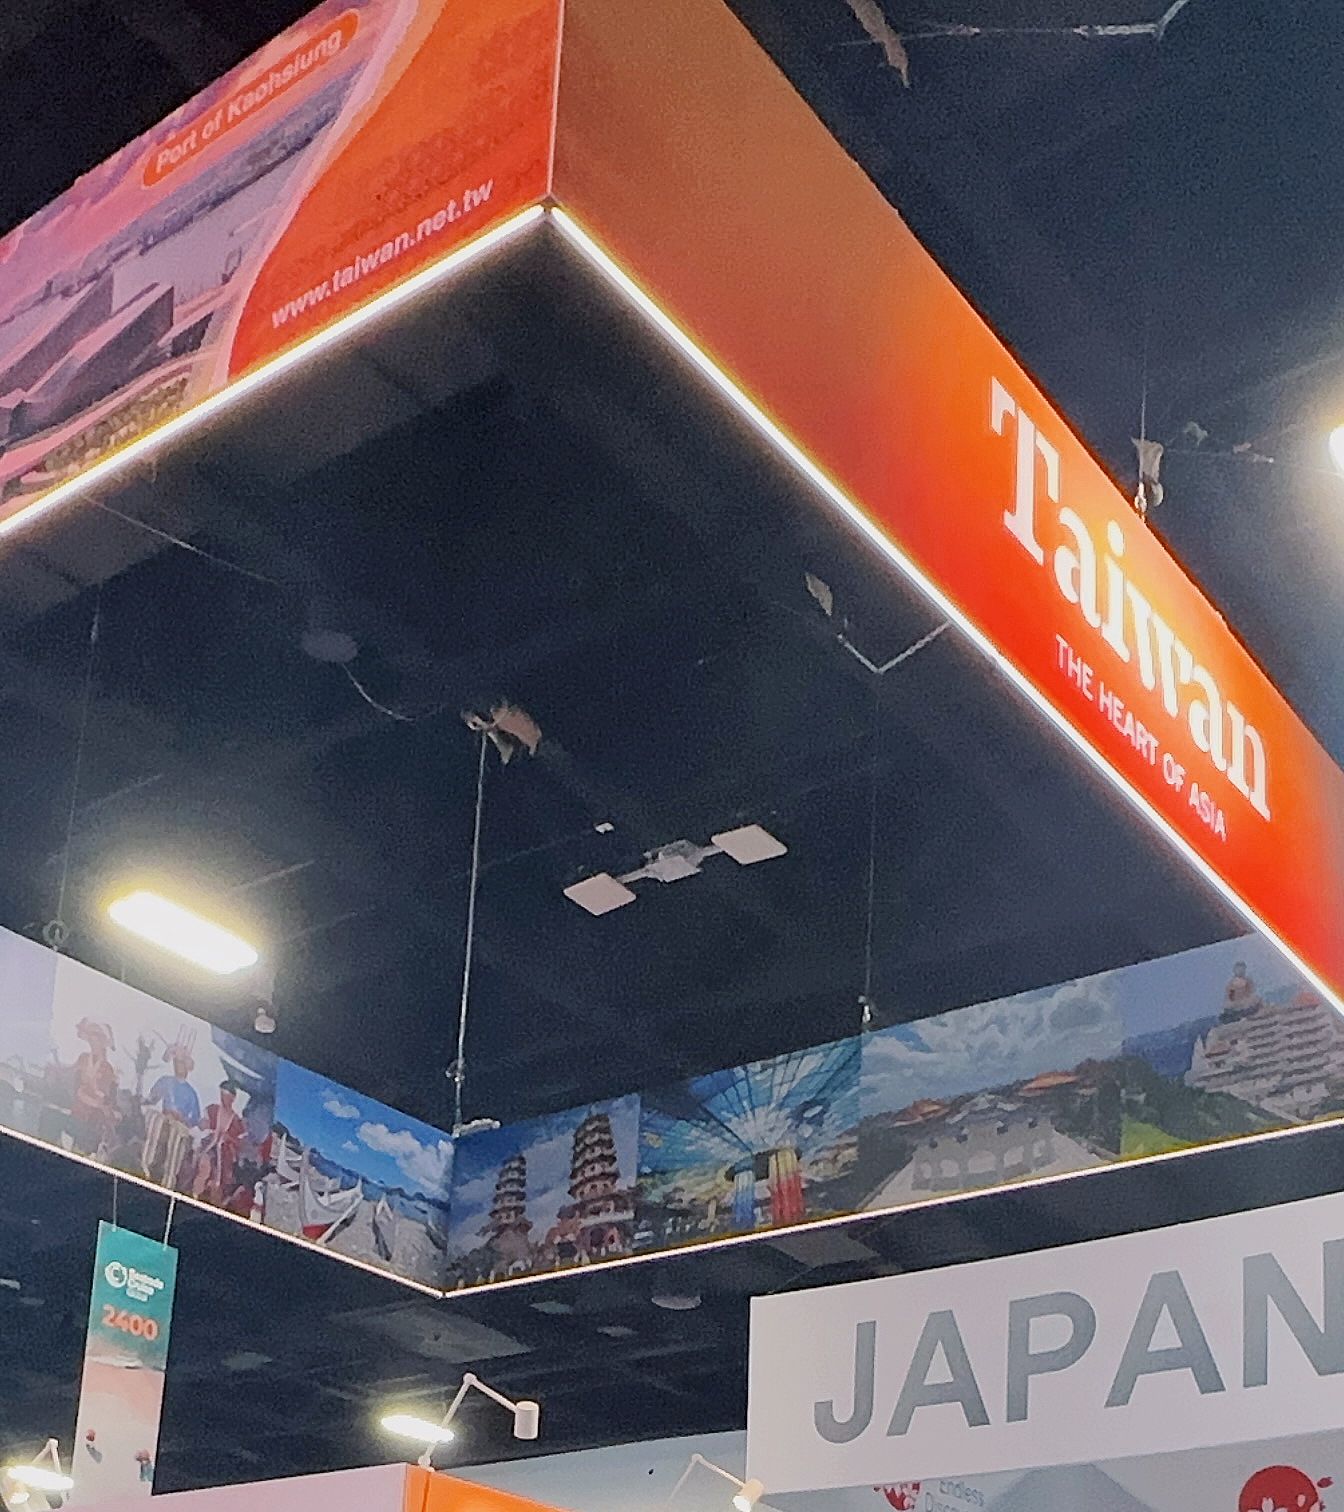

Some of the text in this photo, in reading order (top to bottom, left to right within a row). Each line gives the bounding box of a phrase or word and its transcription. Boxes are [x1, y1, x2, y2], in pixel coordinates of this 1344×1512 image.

[155, 134, 200, 174] Port
[201, 108, 226, 143] of
[271, 178, 494, 329] www.taiwan.net.tw
[989, 375, 1271, 822] Taiwan
[1056, 633, 1227, 842] THE HEART OF ASIA
[102, 1304, 158, 1341] 2400
[939, 1480, 984, 1507] Endless
